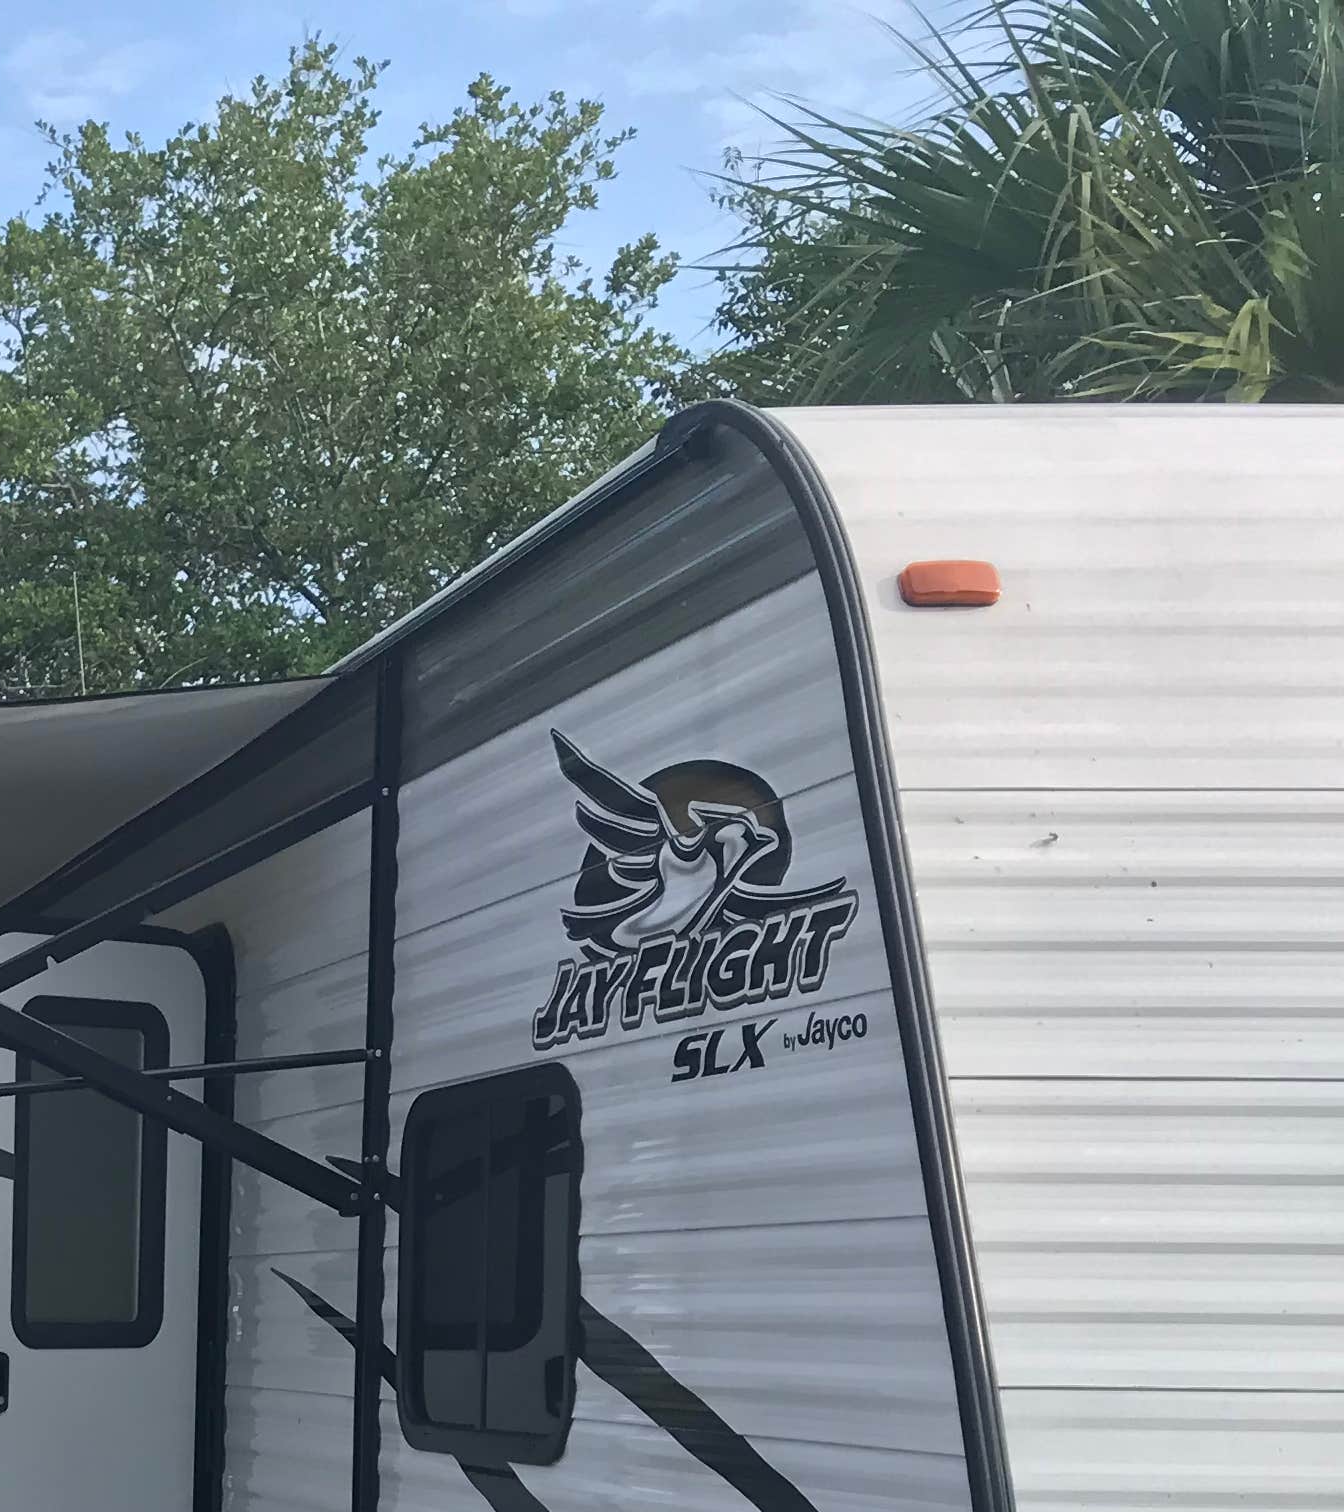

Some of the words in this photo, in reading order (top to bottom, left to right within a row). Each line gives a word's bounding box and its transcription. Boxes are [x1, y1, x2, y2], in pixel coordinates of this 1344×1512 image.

[671, 1018, 778, 1082] SLX
[783, 1032, 797, 1051] by
[797, 1011, 868, 1050] Jayco
